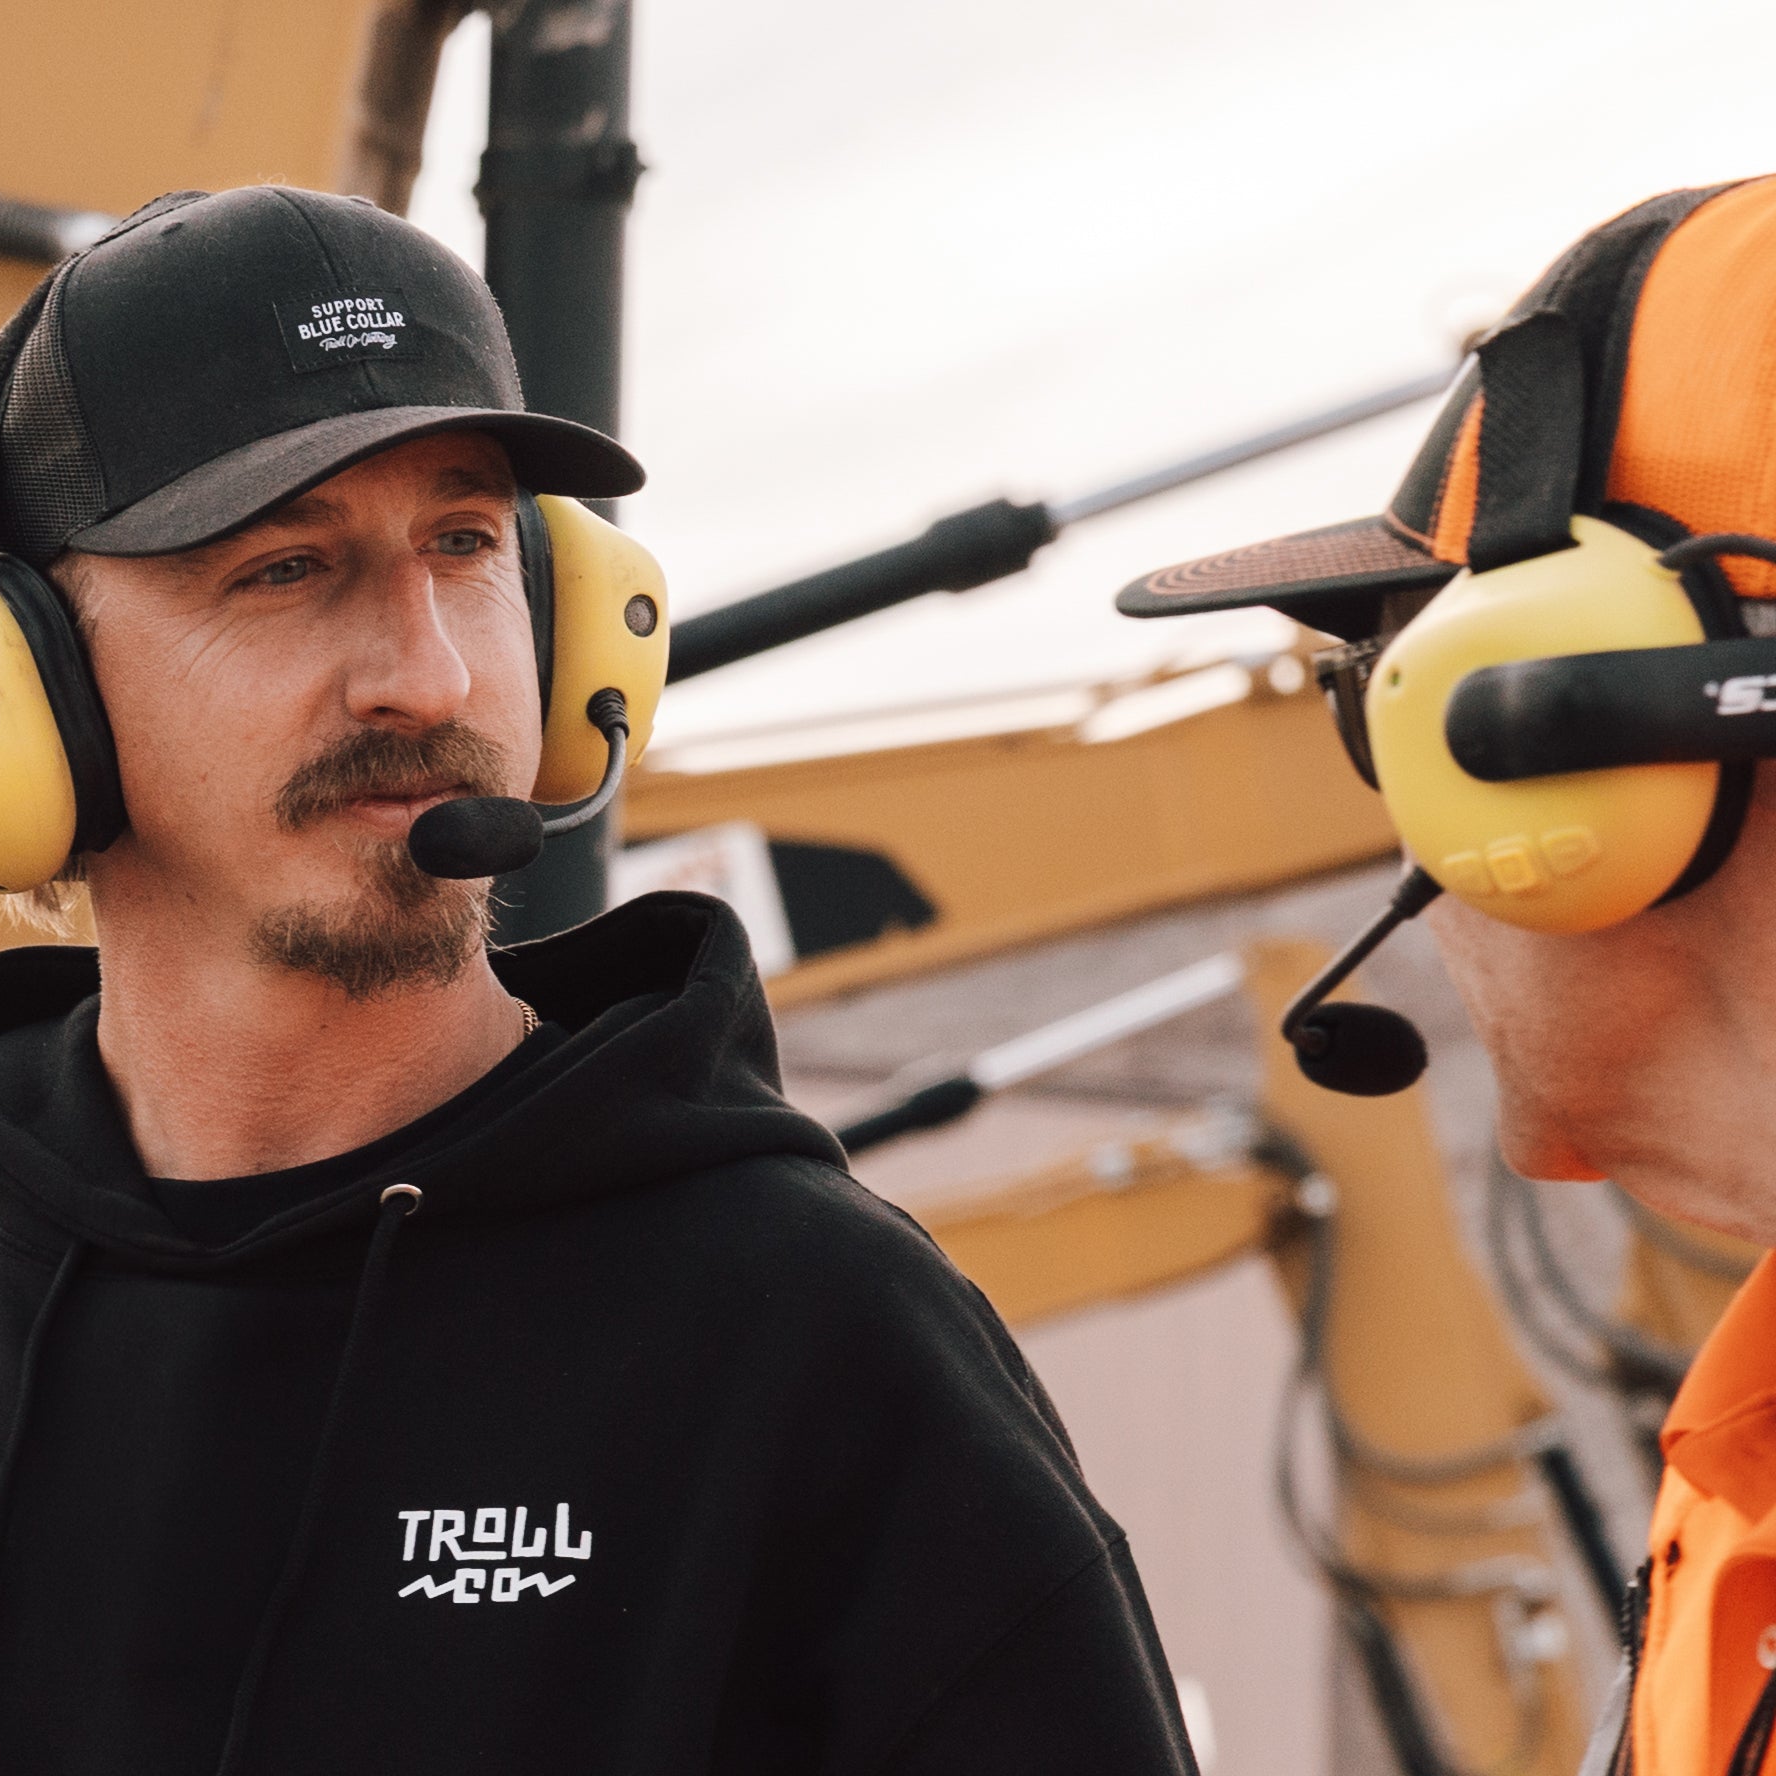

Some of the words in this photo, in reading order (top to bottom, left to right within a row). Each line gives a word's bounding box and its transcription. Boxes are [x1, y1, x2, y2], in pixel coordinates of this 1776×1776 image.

[311, 298, 385, 318] SUPPORT
[298, 316, 344, 339] BLUE
[346, 311, 406, 329] COLLAR
[398, 1503, 592, 1561] TROLL
[453, 1567, 521, 1603] CO
